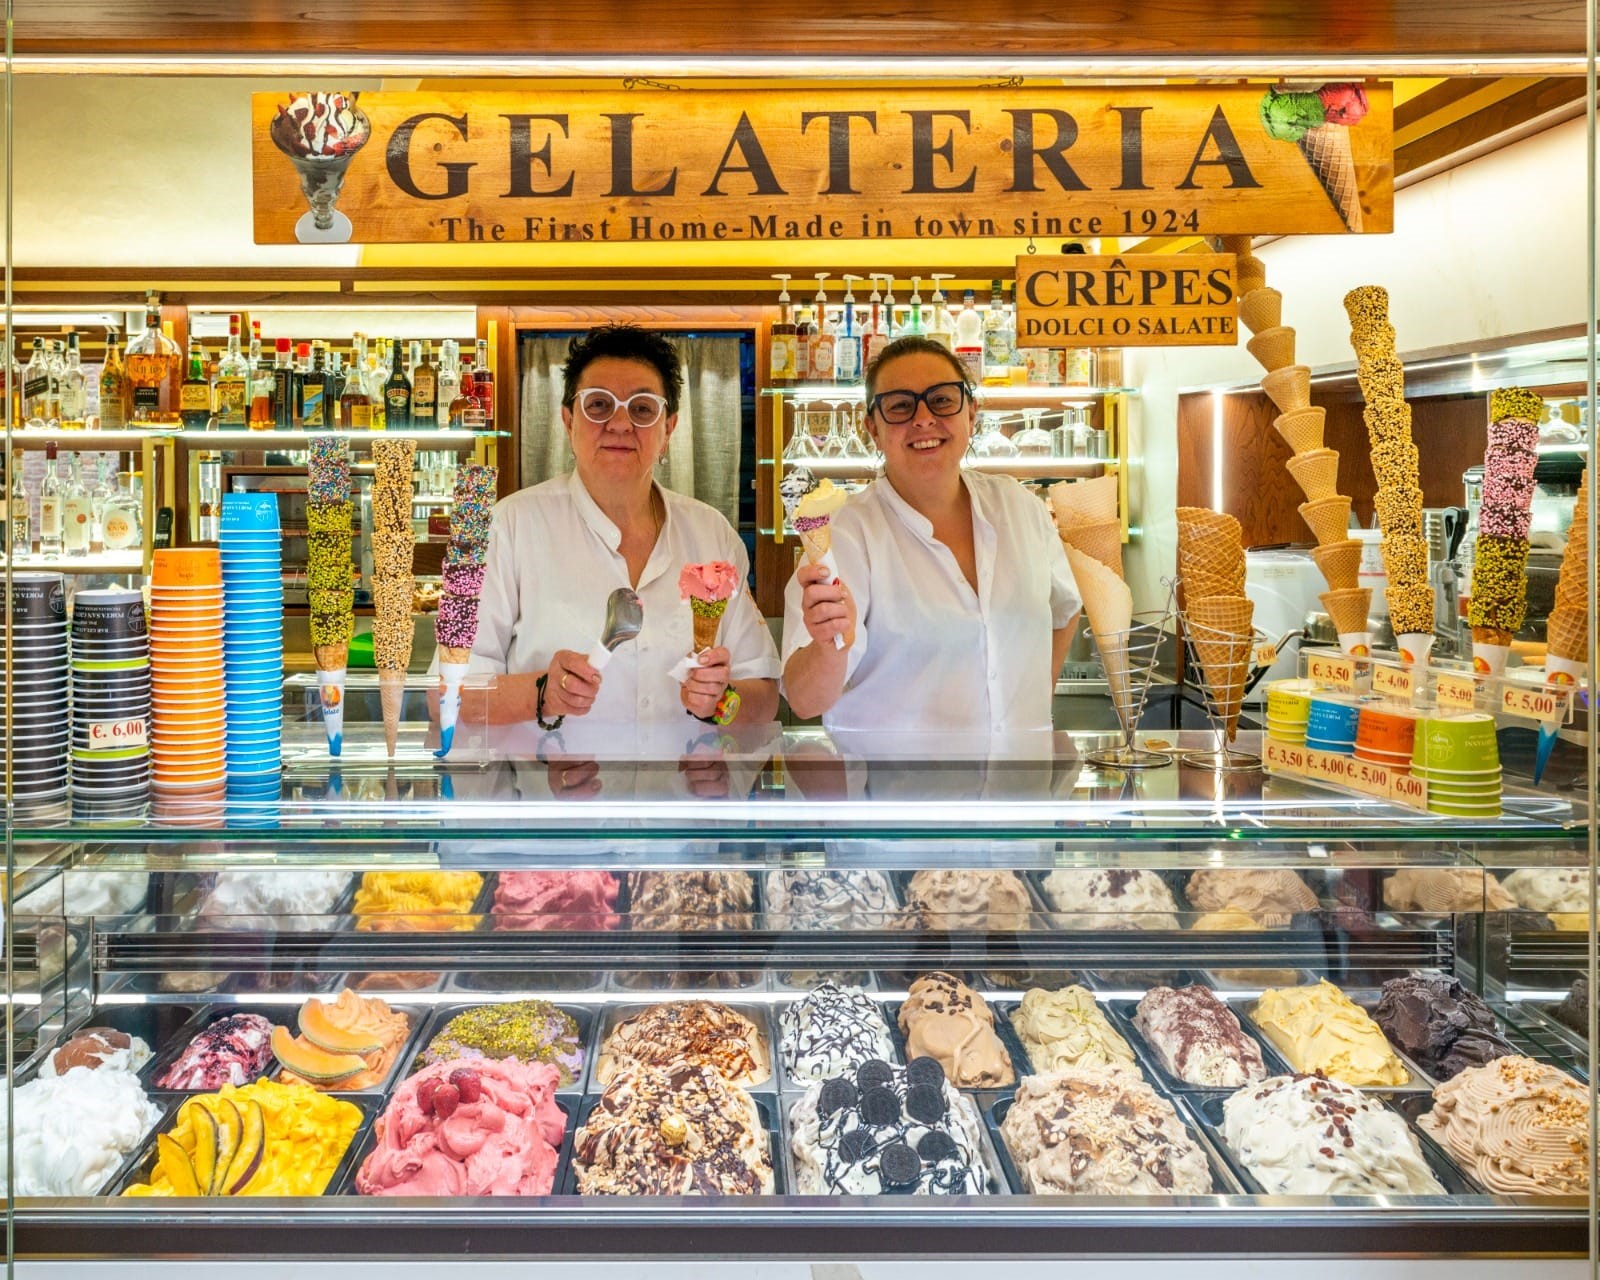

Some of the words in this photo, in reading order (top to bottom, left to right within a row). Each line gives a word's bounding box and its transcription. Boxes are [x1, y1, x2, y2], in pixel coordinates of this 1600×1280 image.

[385, 103, 1264, 200] GELATERIA
[440, 217, 506, 242] The
[524, 217, 612, 242] First
[630, 215, 843, 241] Home-Made
[862, 213, 893, 236] in
[915, 213, 996, 237] town
[1014, 211, 1103, 234] since
[1122, 208, 1200, 234] 1924
[1026, 258, 1233, 307] CRÊPES
[1026, 318, 1105, 336] DOLCI
[1112, 318, 1131, 336] O
[1137, 317, 1234, 335] SALATE
[1312, 663, 1323, 678] €.
[1325, 664, 1350, 682] 3,50
[1375, 670, 1385, 683] €.
[1387, 673, 1409, 690] 4,00
[1437, 683, 1447, 697] €.
[1449, 686, 1472, 702] 5,00
[1504, 690, 1517, 706] €.
[1521, 695, 1553, 714] 5,00
[92, 724, 107, 739] €.
[112, 721, 143, 738] 6,00
[1267, 745, 1278, 761] €.
[1279, 749, 1303, 767] 3,50
[1306, 753, 1318, 769] €.
[1320, 758, 1345, 775] 4,00
[1346, 764, 1358, 779] €.
[1361, 767, 1387, 786] 5,00
[1395, 777, 1422, 797] 6,00
